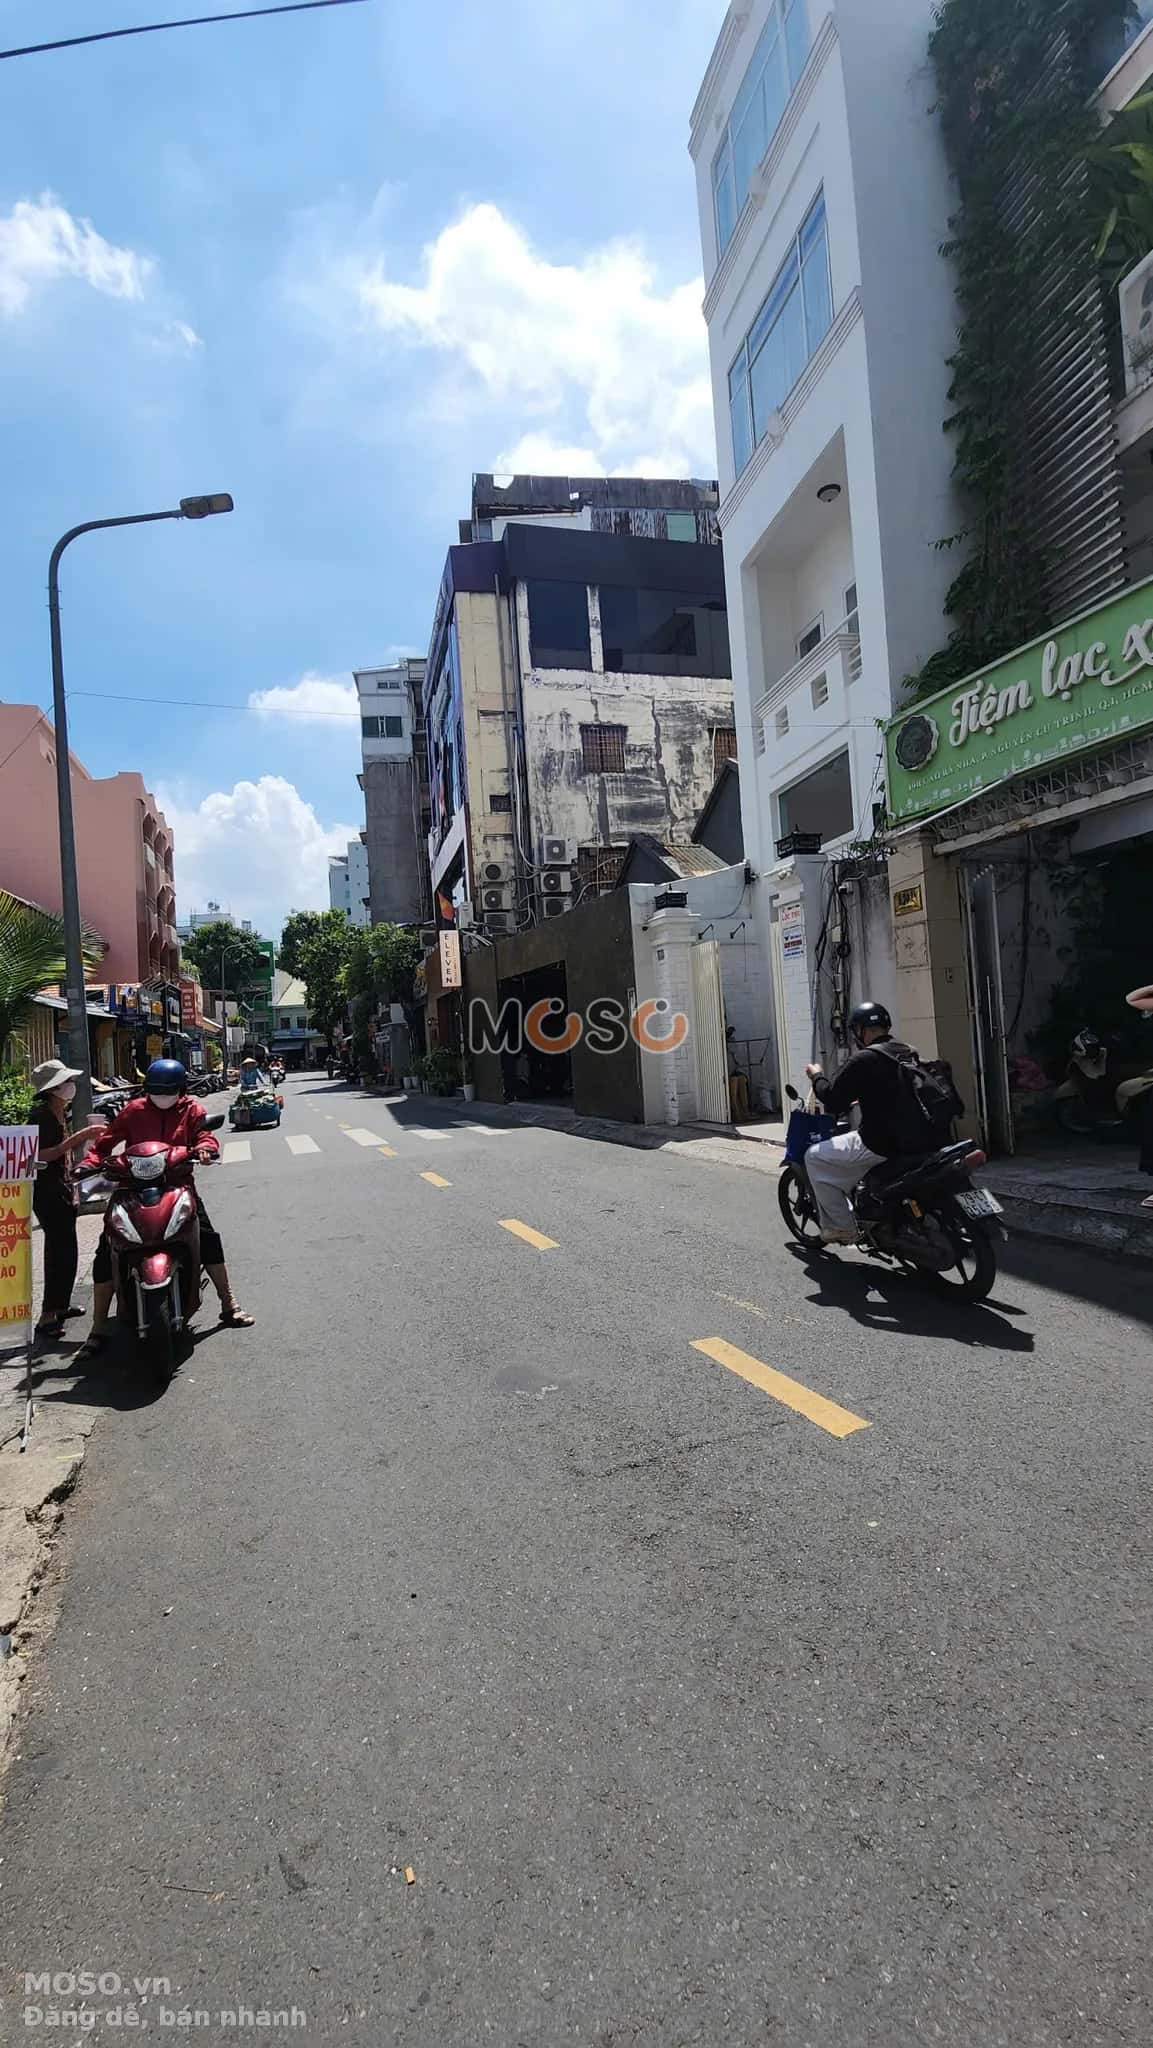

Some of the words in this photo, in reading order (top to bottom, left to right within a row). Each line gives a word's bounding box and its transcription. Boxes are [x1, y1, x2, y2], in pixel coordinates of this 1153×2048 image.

[948, 679, 1034, 748] Tiệm
[1041, 639, 1109, 702] lạc
[444, 933, 453, 984] ELEVEN
